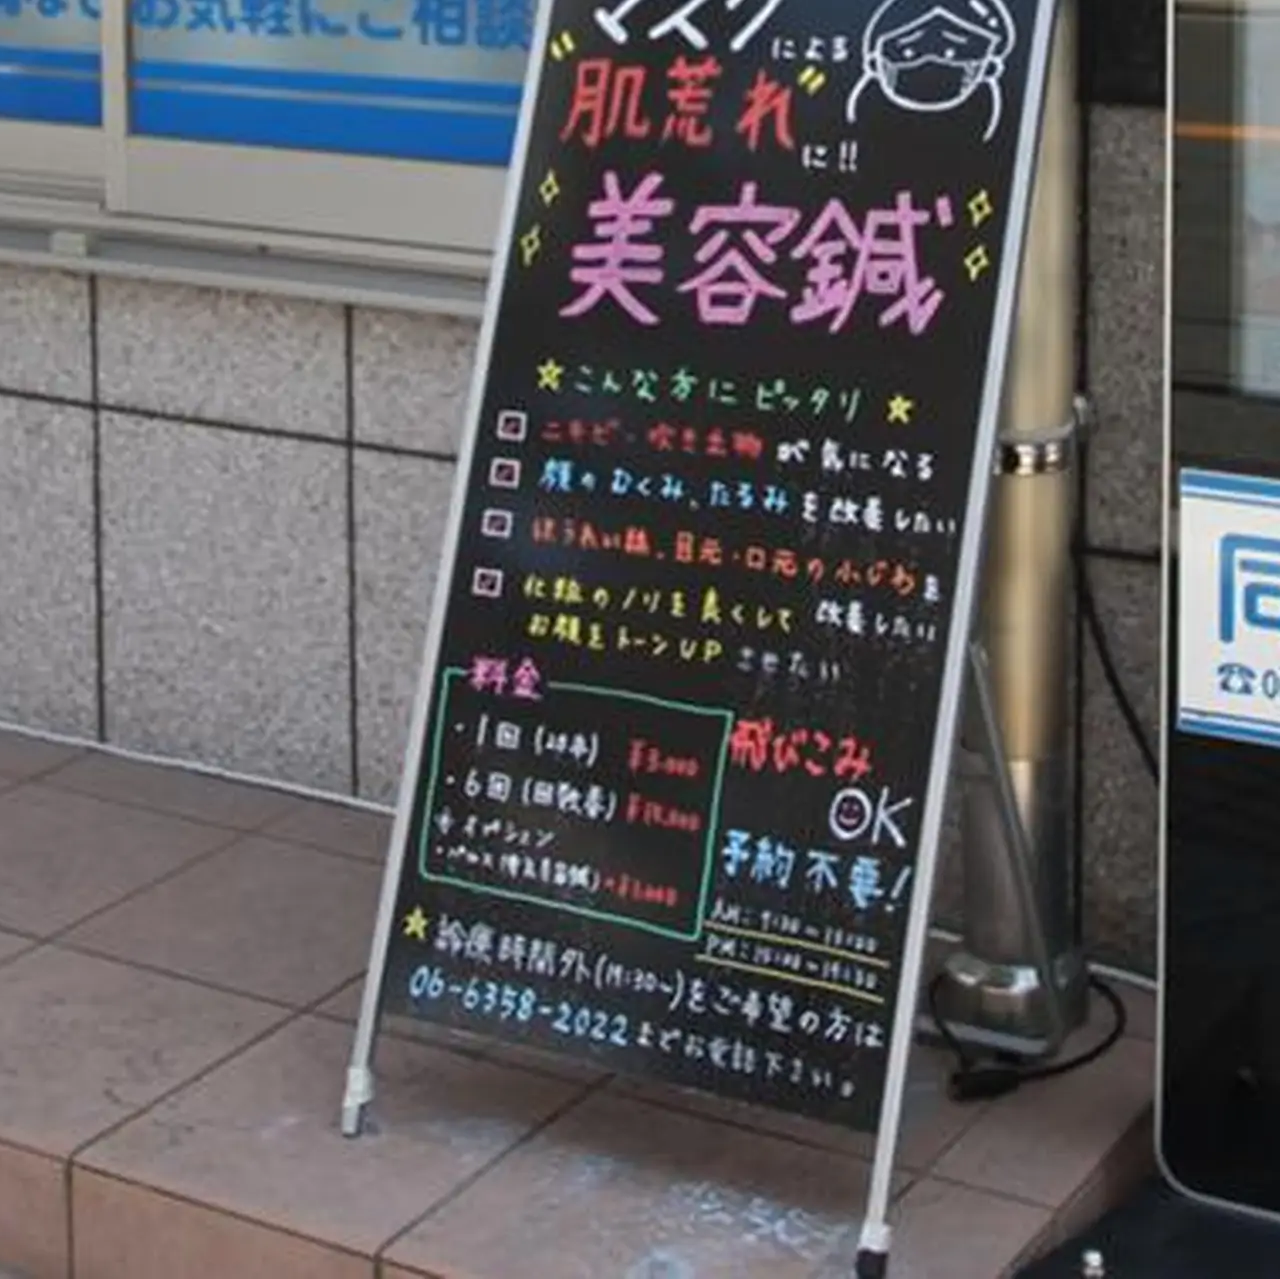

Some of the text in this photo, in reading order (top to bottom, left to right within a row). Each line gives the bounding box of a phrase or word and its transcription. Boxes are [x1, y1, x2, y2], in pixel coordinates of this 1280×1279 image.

[559, 171, 951, 334] 美容鍼
[574, 364, 862, 422] こんな方にピッタリ
[466, 655, 544, 699] 料金
[729, 718, 876, 779] 飛びこみ
[829, 784, 914, 848] OK
